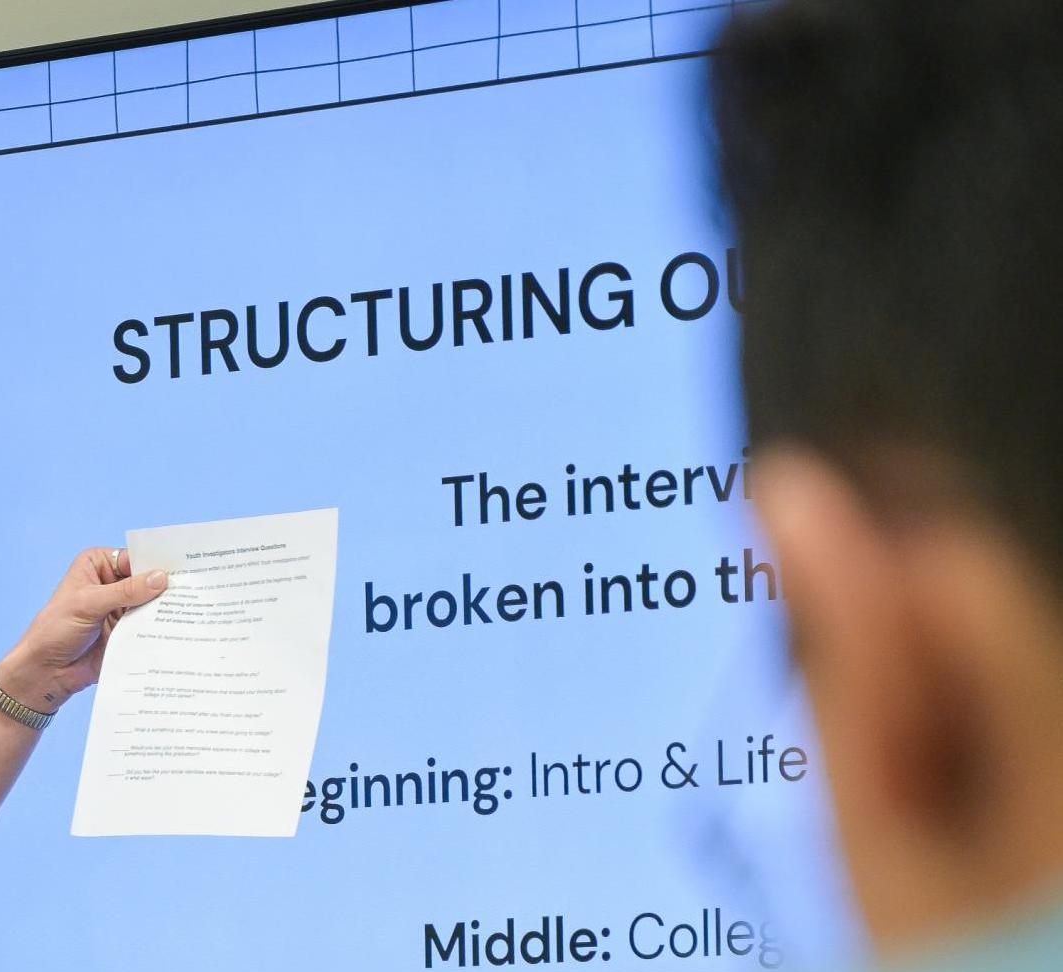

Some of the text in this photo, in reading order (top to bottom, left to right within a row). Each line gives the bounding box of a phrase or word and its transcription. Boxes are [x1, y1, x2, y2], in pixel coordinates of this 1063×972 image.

[112, 261, 635, 385] STRUCTURING
[441, 471, 547, 527] The
[364, 572, 565, 634] broken
[583, 562, 697, 616] into
[531, 751, 643, 798] Intro
[661, 741, 700, 790] &
[717, 734, 809, 786] Life
[424, 915, 611, 969] Middle:
